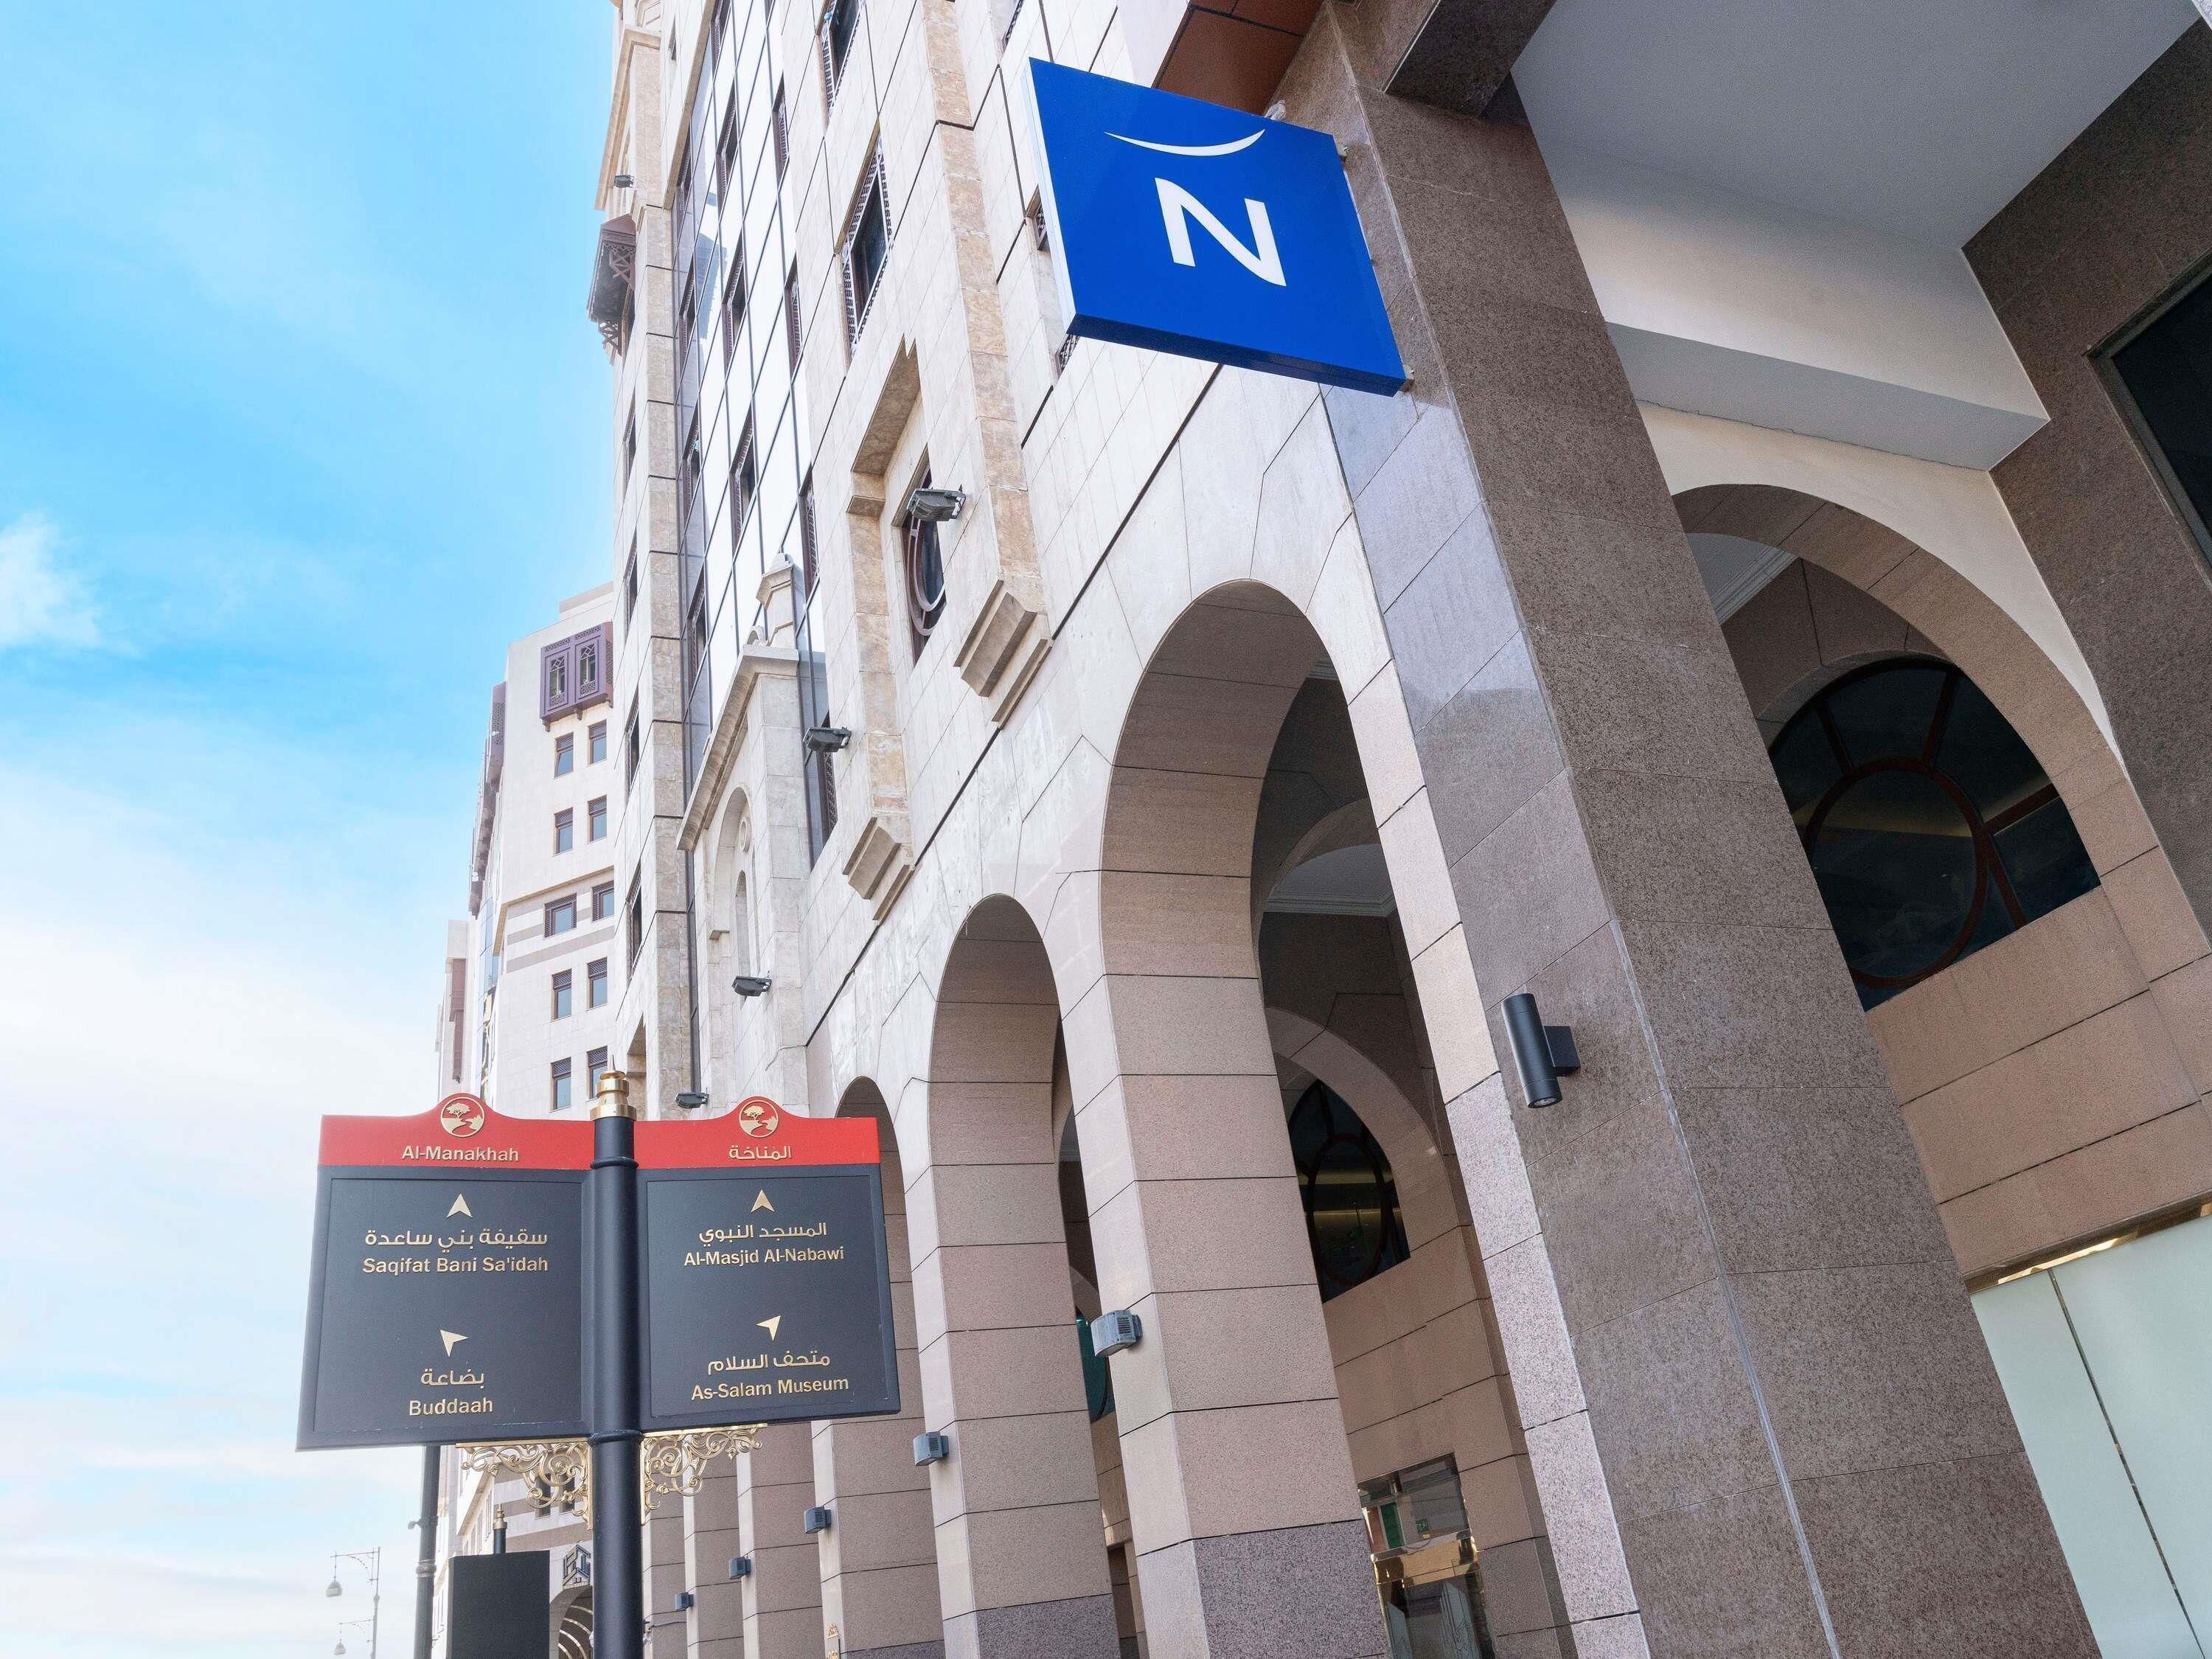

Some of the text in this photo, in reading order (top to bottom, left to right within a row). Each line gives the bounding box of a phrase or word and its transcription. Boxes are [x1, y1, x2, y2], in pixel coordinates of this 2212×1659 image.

[1154, 177, 1287, 287] N
[400, 1144, 520, 1162] Al-Manakhah
[728, 1144, 793, 1161] المناخة
[364, 1228, 549, 1254] سقيفة بني ساعدة
[698, 1222, 827, 1248] المسجد النبوي
[362, 1256, 549, 1276] Saqifat Bani Sa'idah
[684, 1246, 844, 1267] Al-Masjid Al-Nabawi
[707, 1350, 831, 1376] متحف السلام
[420, 1368, 485, 1390] بضاعة
[691, 1377, 849, 1402] As-Salam Museum
[408, 1397, 493, 1417] Buddaah
